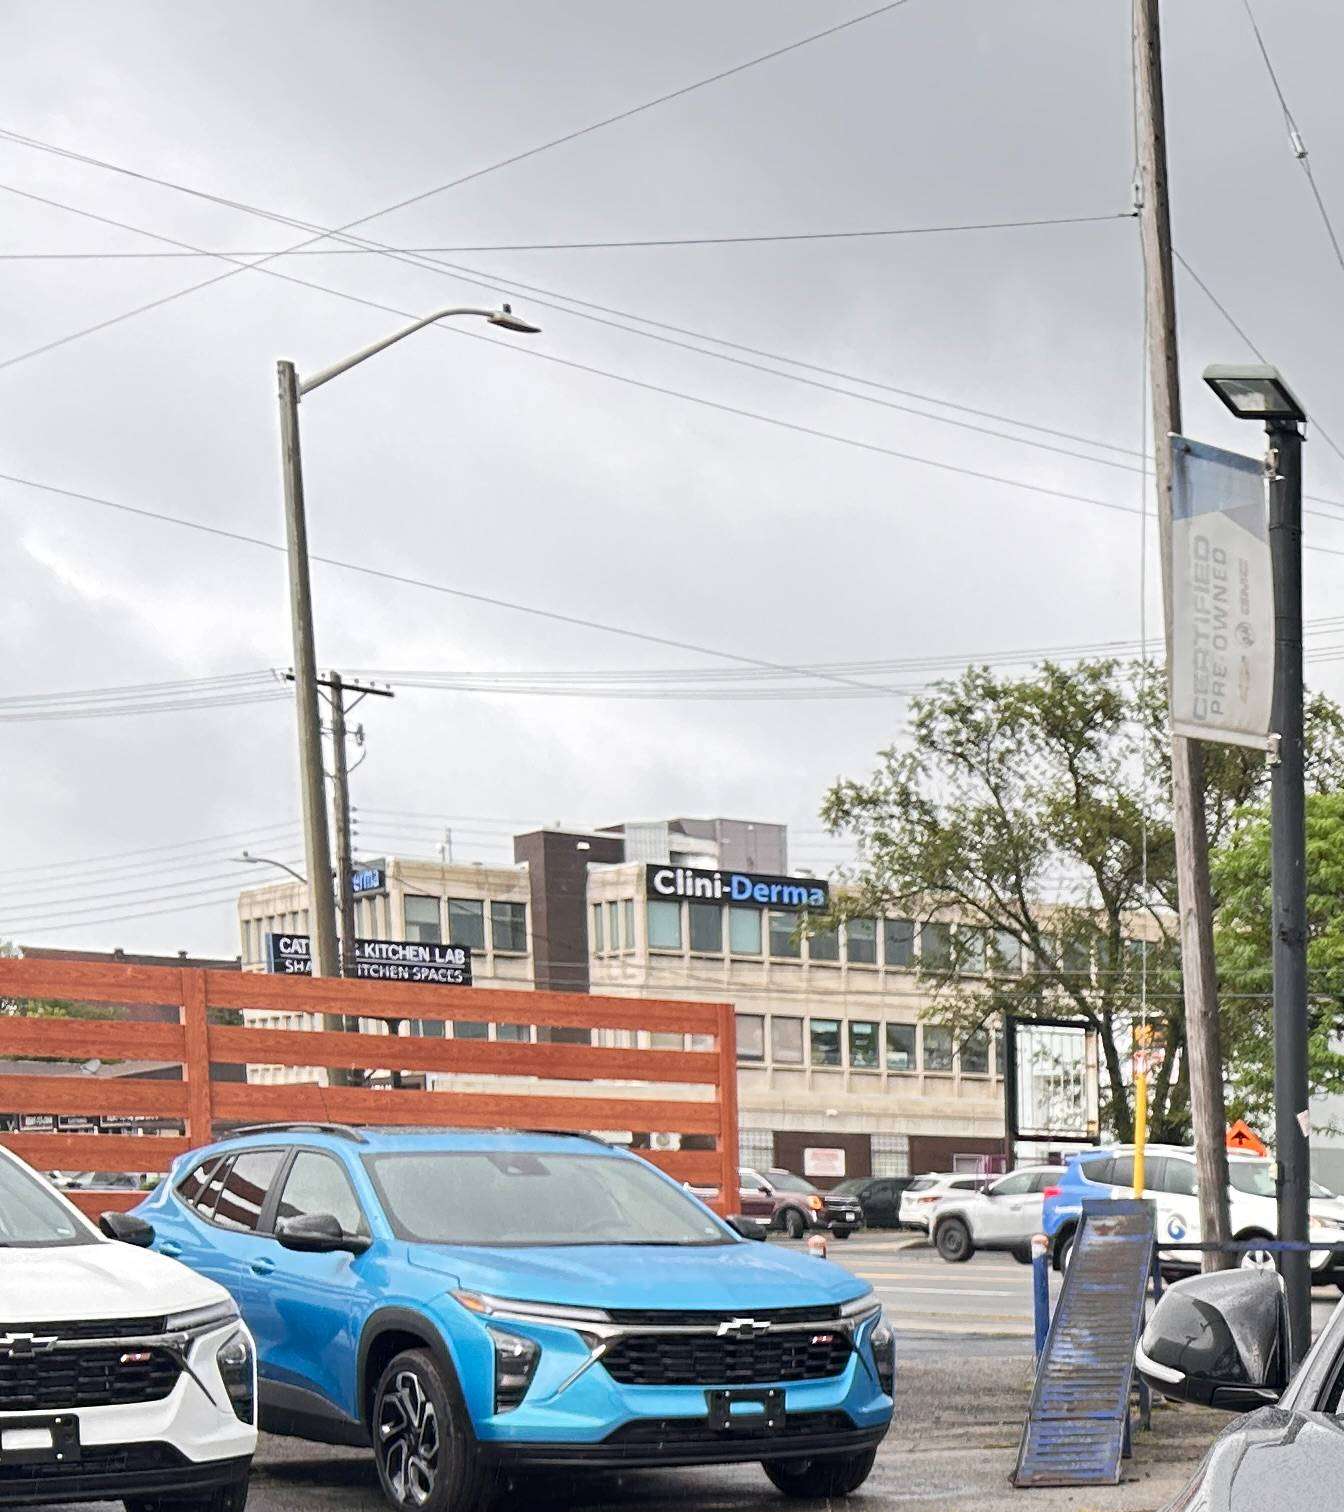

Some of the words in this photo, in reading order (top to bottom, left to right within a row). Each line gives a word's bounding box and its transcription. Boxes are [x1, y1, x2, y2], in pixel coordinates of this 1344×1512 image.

[1193, 535, 1211, 721] CERTIFIED
[653, 868, 825, 905] Clini-Derma
[364, 942, 430, 962] KITCHEN
[435, 947, 466, 965] LAB
[357, 964, 409, 980] ITCHEN
[412, 967, 464, 984] SPACES
